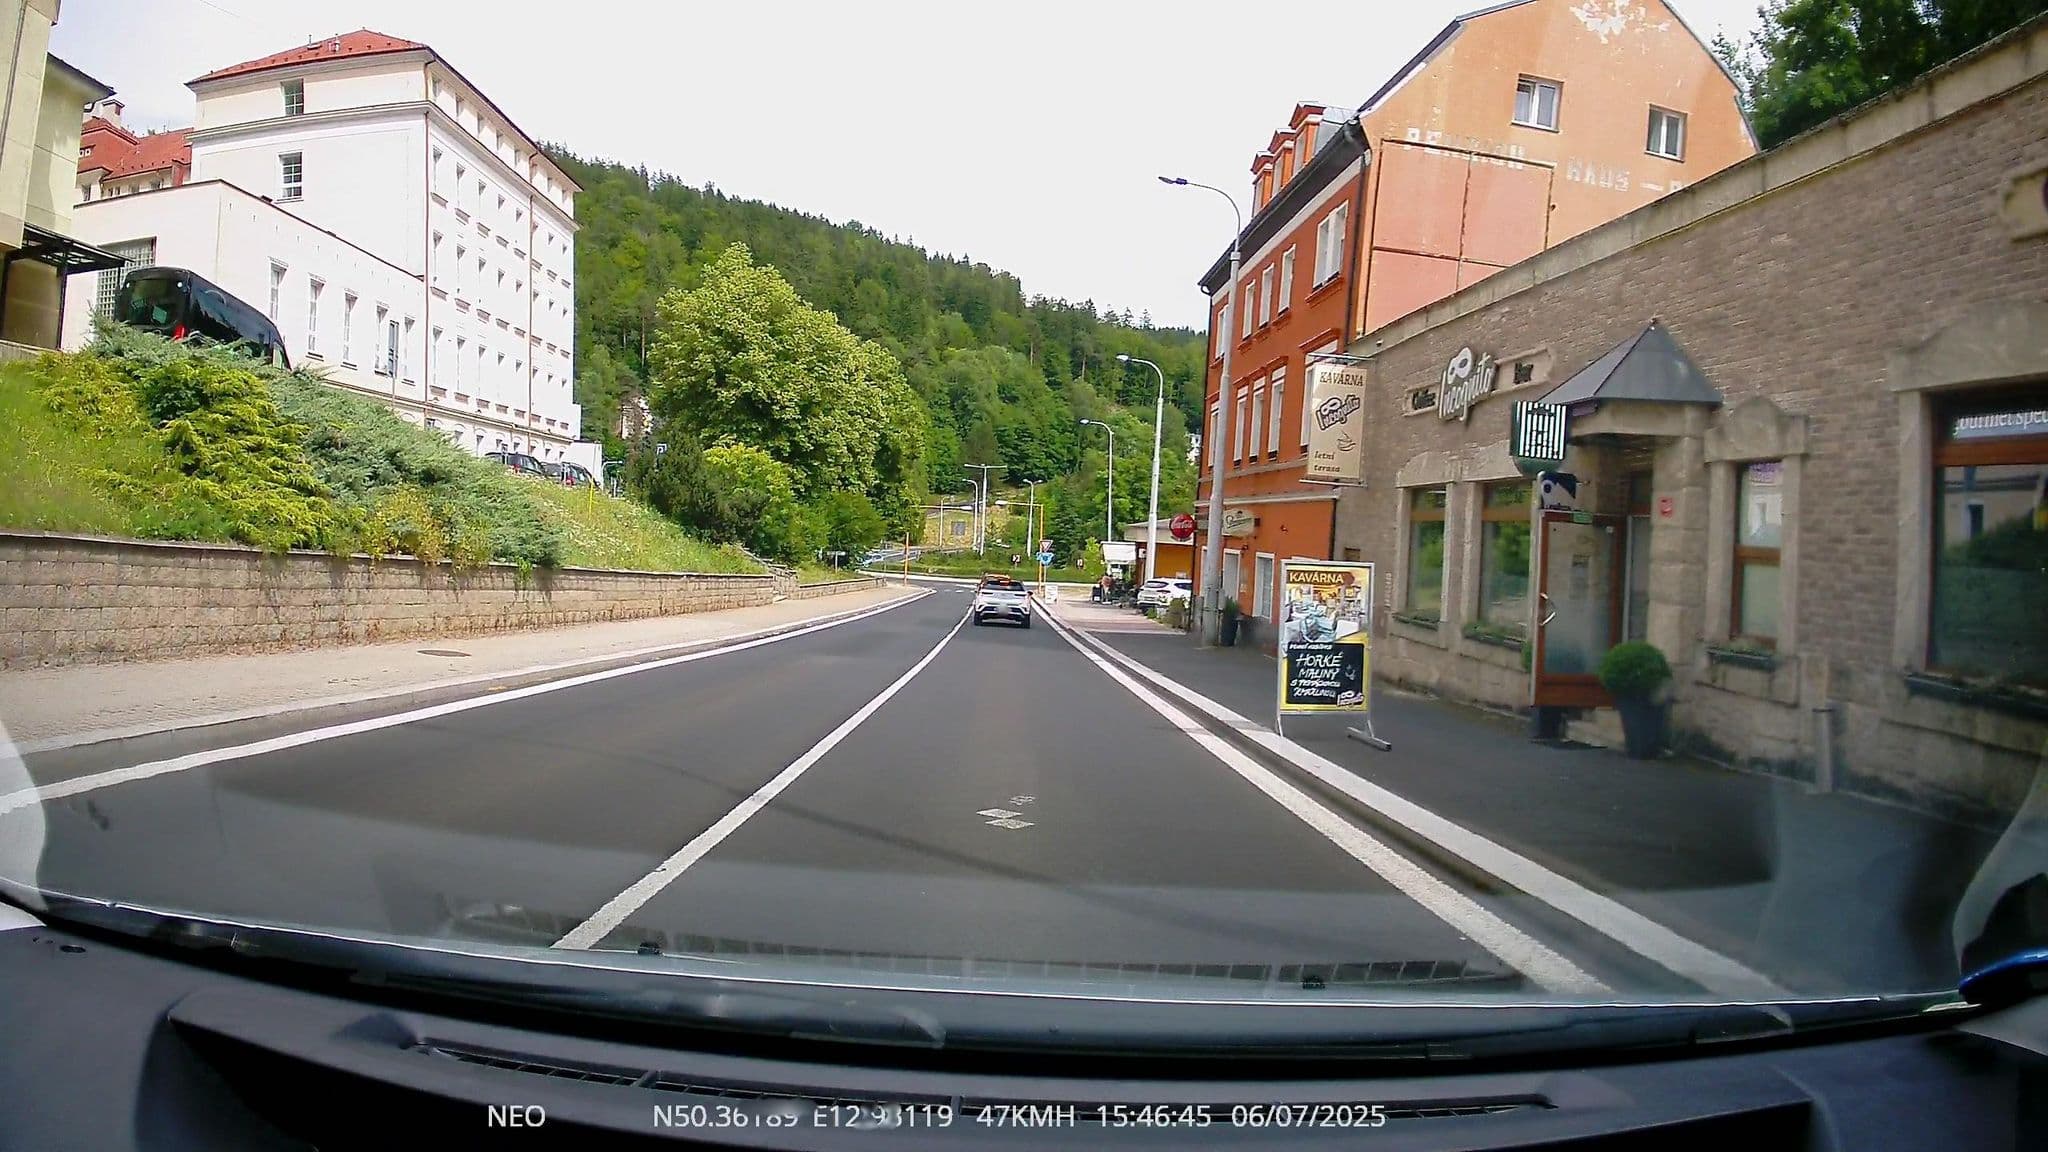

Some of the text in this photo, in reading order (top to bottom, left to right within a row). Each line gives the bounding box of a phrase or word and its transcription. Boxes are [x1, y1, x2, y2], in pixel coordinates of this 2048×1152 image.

[1320, 370, 1364, 386] KAVÁRNA
[1439, 352, 1491, 421] Incognito
[1289, 570, 1344, 584] KAVÁRNA
[1296, 651, 1344, 667] HORKÉ
[1299, 668, 1340, 680] MALINY
